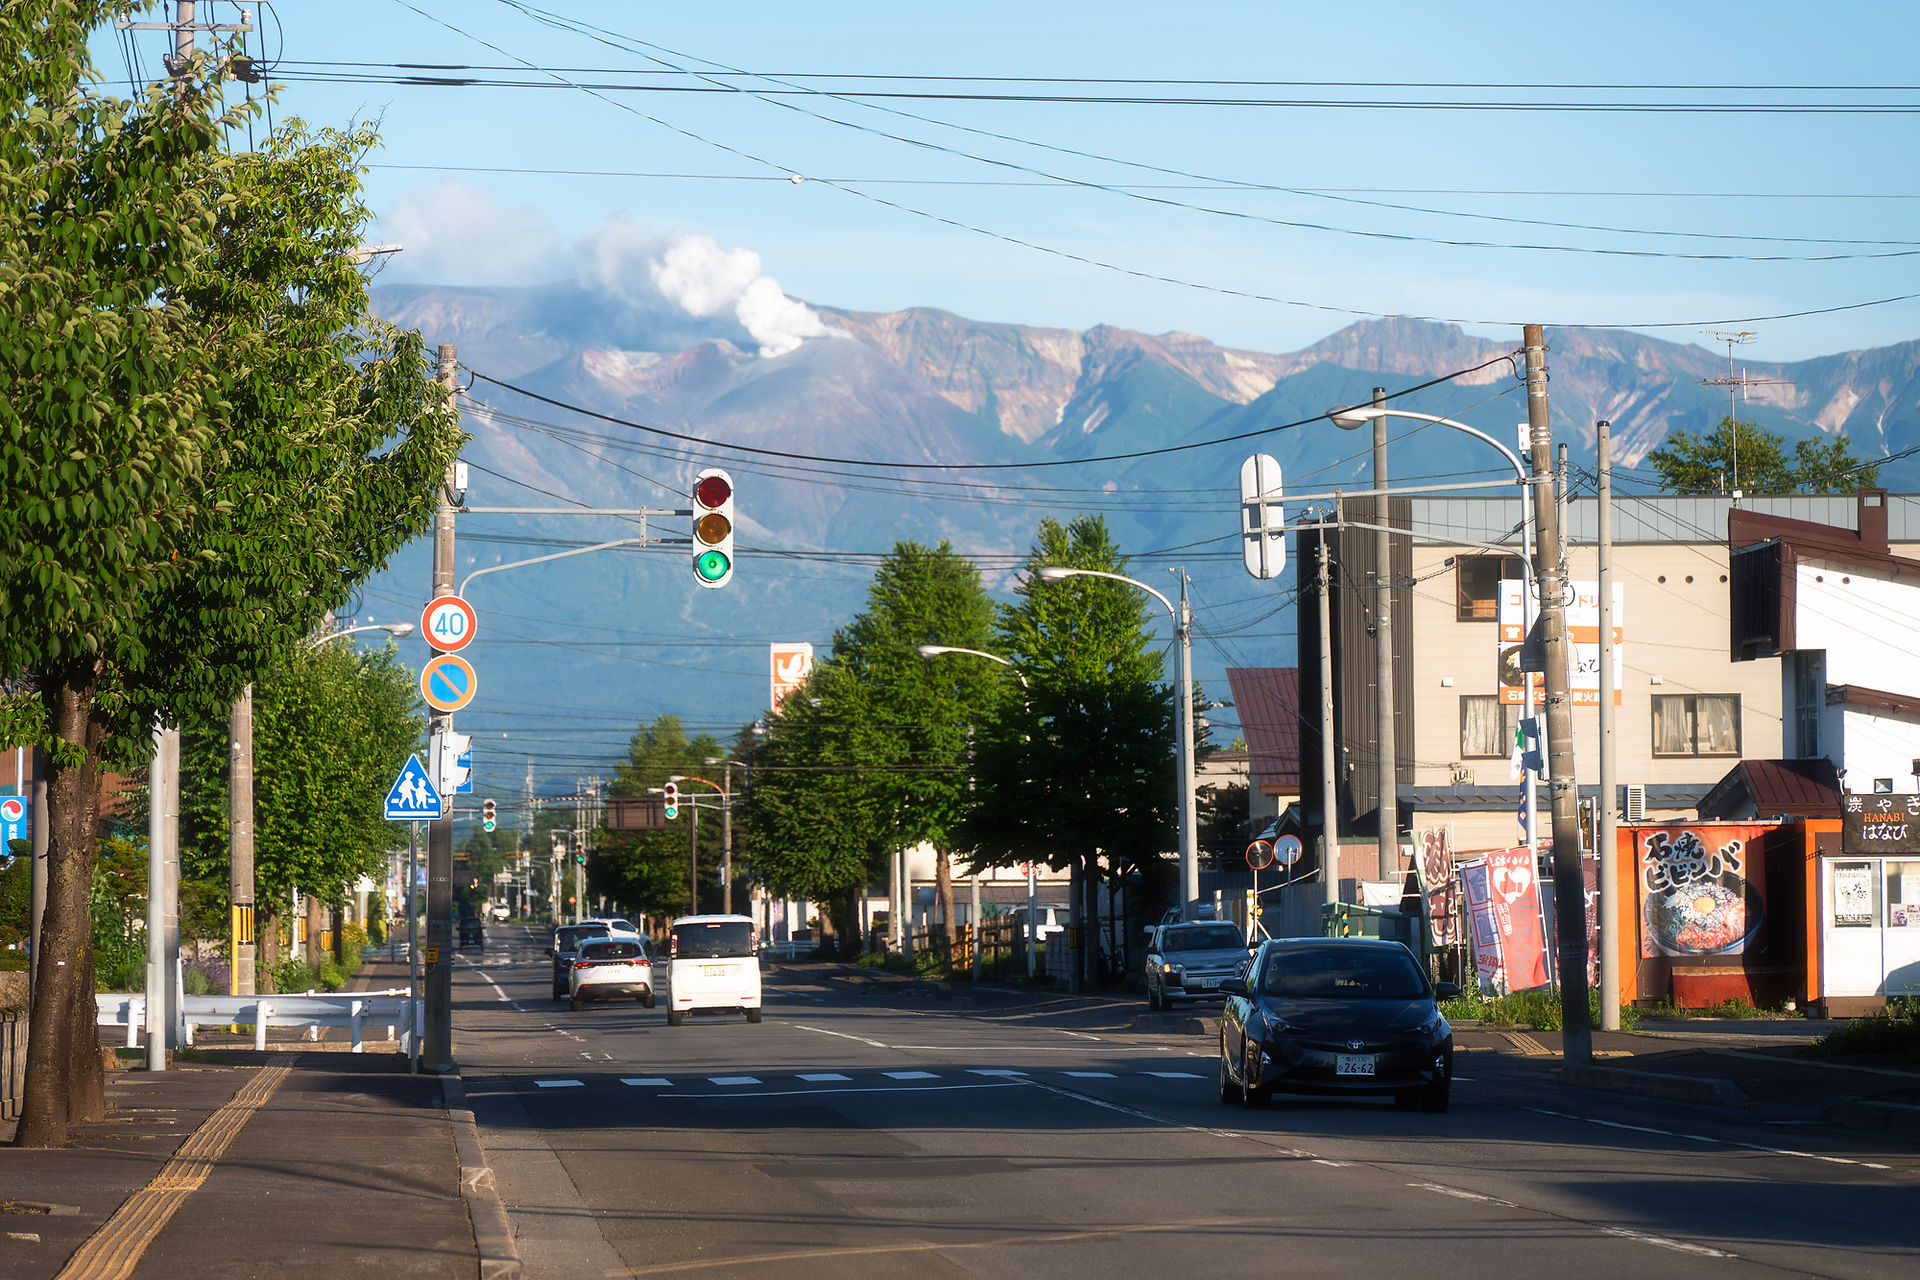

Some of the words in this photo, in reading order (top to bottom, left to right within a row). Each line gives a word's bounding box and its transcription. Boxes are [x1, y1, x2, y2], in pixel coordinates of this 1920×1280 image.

[435, 612, 464, 636] 40
[1847, 795, 1920, 815] 炭やき
[1863, 812, 1905, 823] HANABI
[1862, 822, 1908, 840] はなび
[1644, 830, 1706, 862] 石焼
[1645, 840, 1741, 893] ビビンバ
[1344, 1063, 1374, 1073] 26-62
